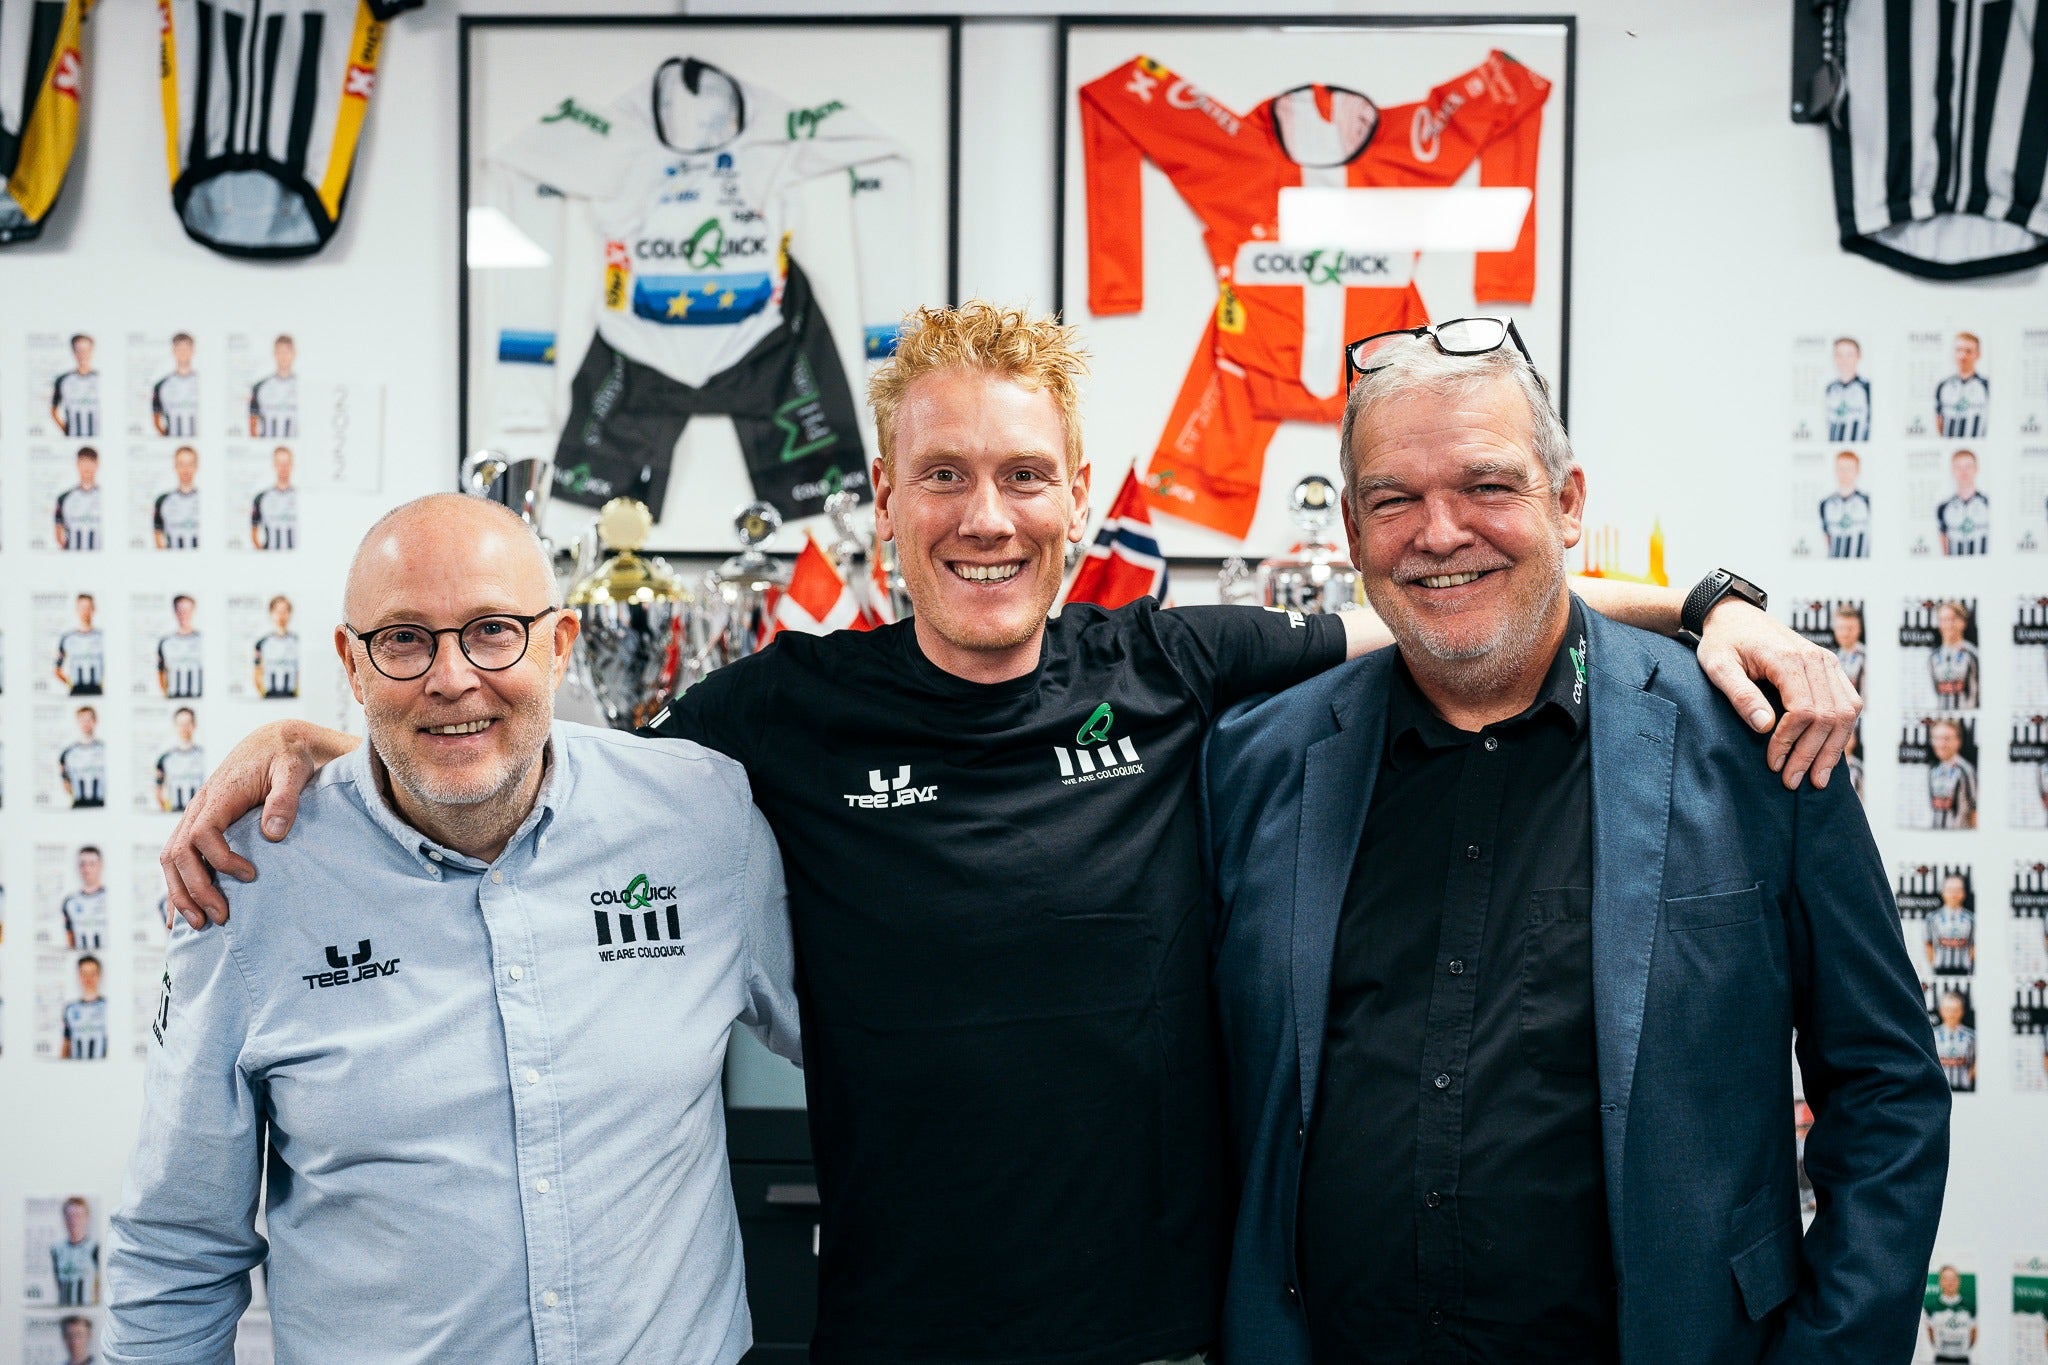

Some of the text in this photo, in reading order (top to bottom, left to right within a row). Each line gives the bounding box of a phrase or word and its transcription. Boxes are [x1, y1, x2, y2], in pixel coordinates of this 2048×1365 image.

[636, 218, 768, 270] COLOQUICK
[1061, 763, 1146, 786] WE ARE COLOQUICK
[590, 873, 678, 910] COLOQUICK
[599, 945, 687, 962] WE ARE COLOQUICK
